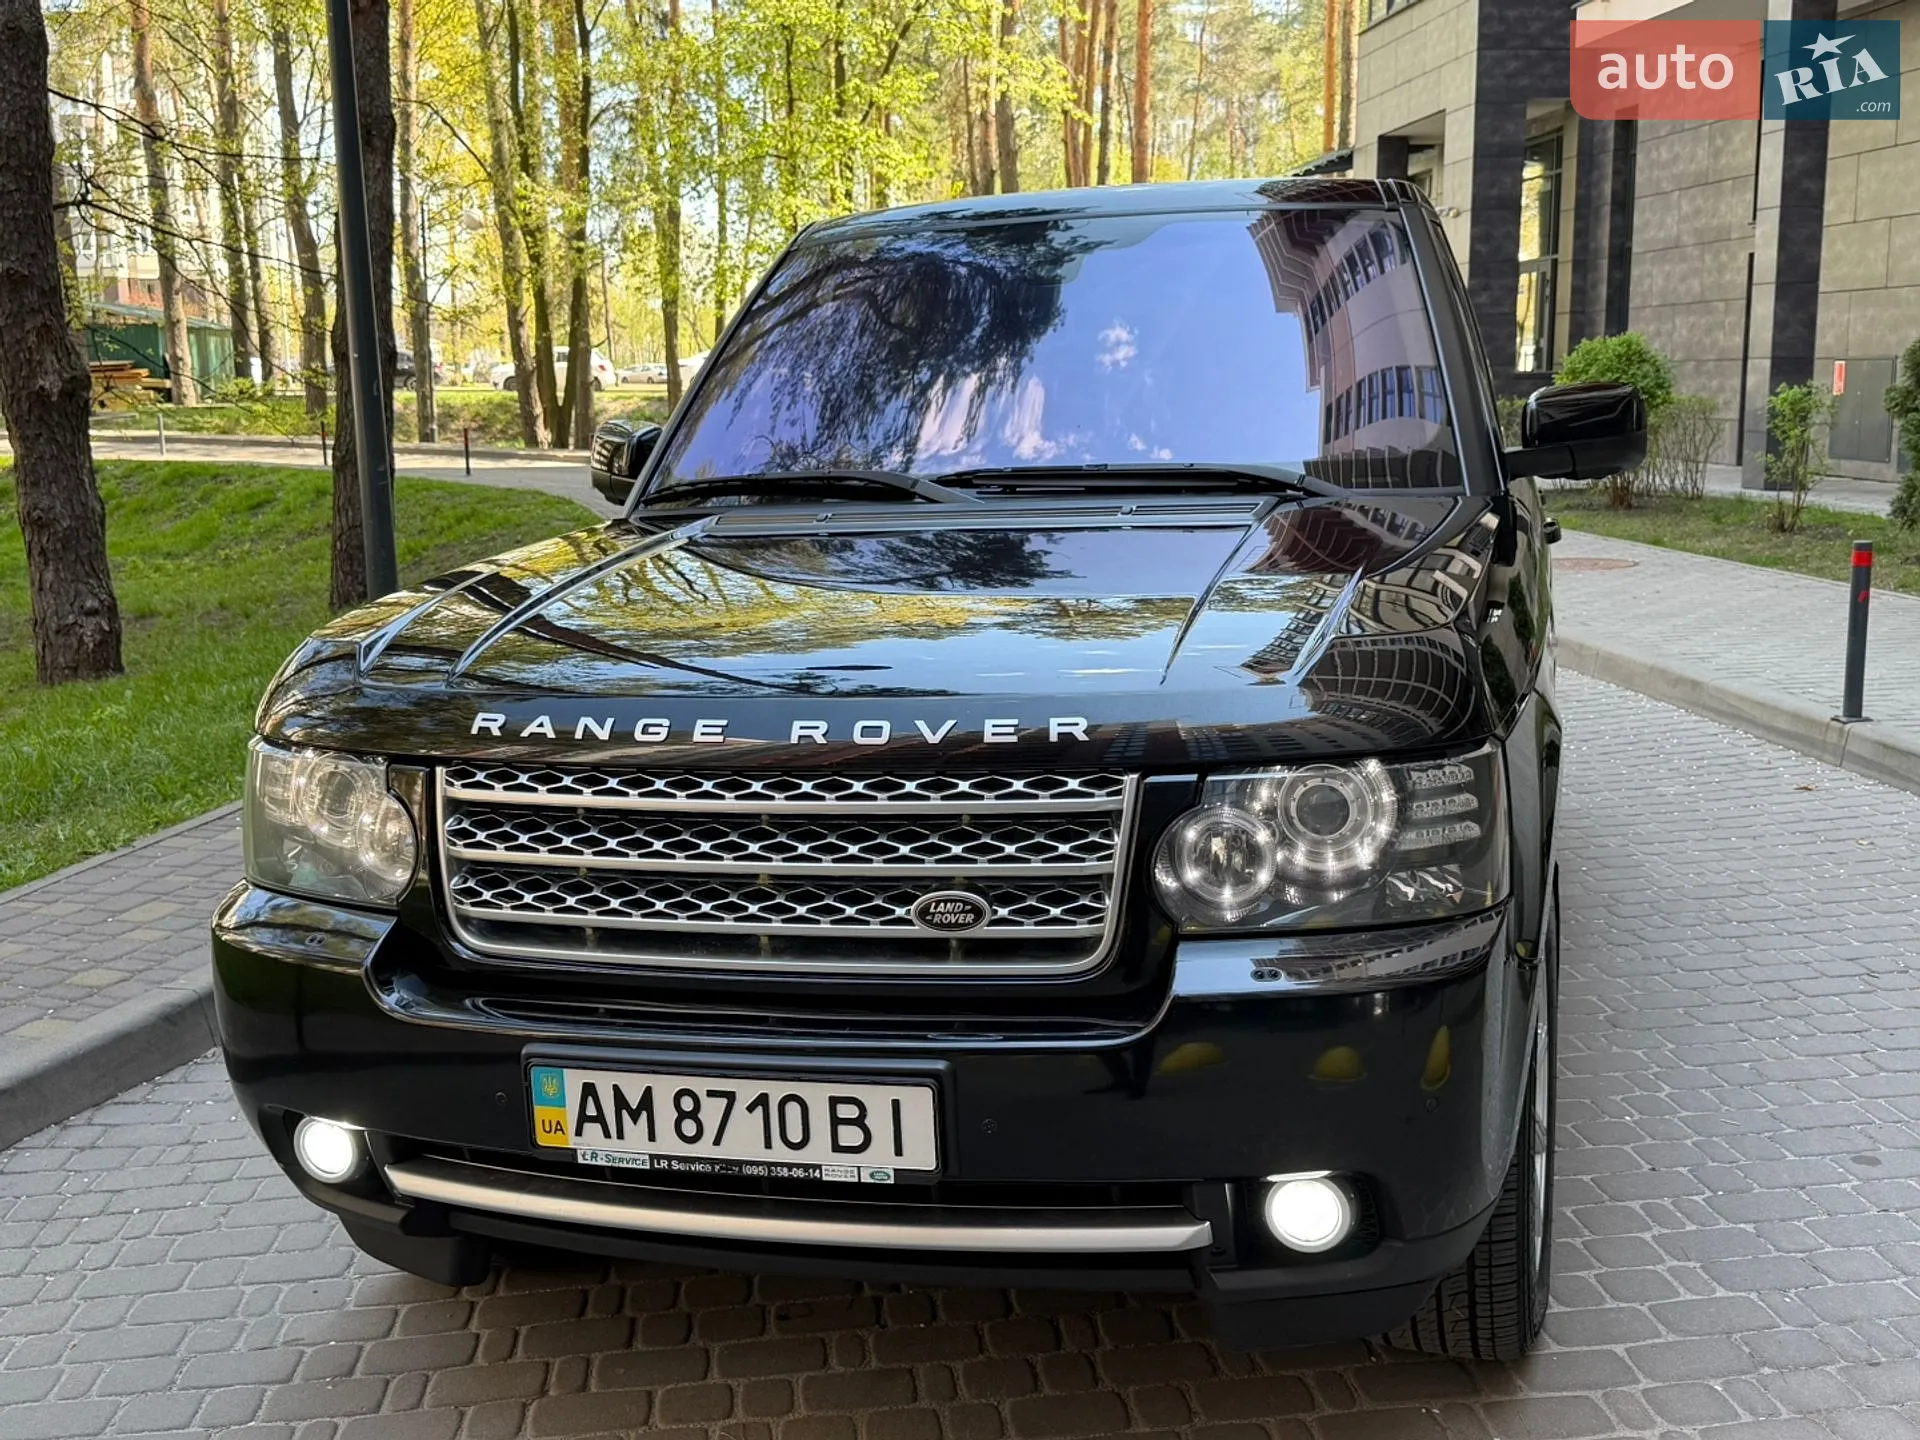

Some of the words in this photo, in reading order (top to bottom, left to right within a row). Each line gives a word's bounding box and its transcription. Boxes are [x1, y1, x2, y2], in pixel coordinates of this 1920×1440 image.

[470, 712, 728, 743] RANGE
[790, 717, 1090, 745] ROVER
[929, 902, 964, 913] LAND
[933, 913, 975, 924] ROVER
[541, 1119, 566, 1135] UA
[574, 1081, 656, 1142] AM
[673, 1088, 811, 1150] 8710
[829, 1095, 903, 1157] BI
